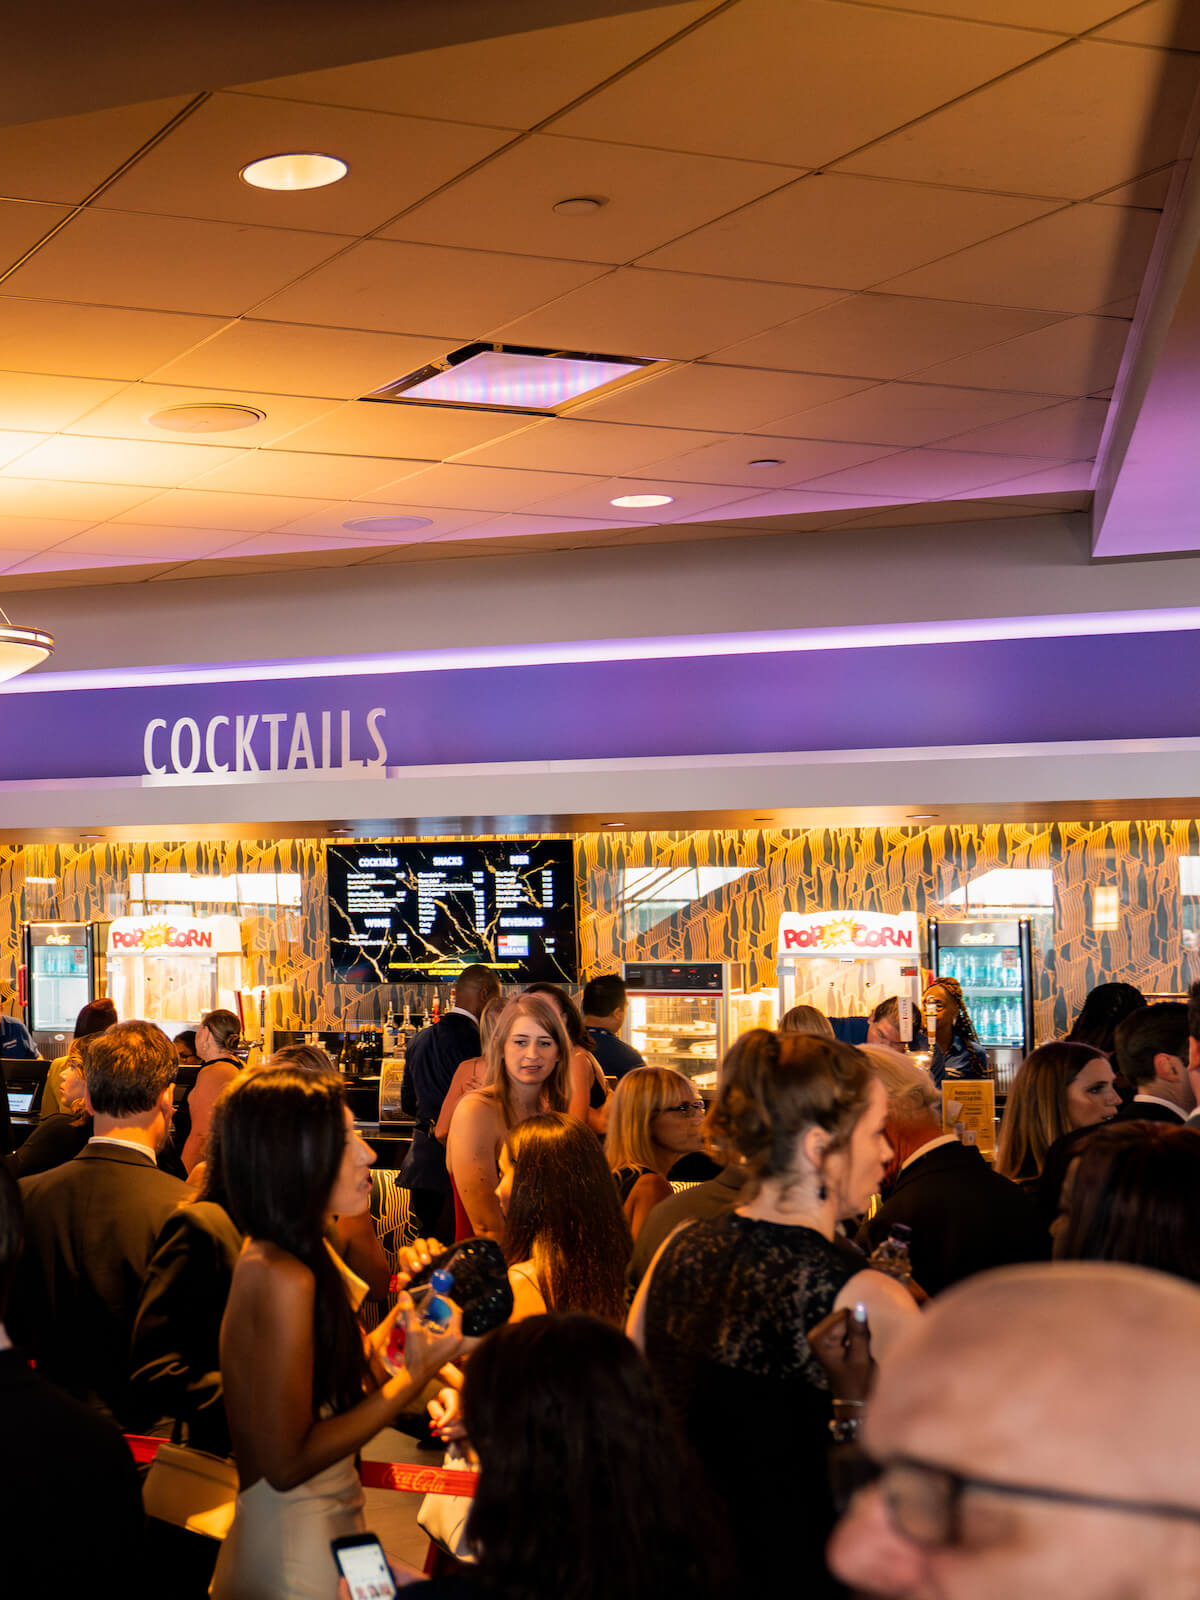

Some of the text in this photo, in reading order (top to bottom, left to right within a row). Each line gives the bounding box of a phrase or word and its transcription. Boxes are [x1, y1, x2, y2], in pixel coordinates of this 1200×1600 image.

[143, 707, 388, 775] COCKTAILS
[358, 857, 398, 867] COCKTAILS
[432, 856, 463, 866] SNACKS
[364, 918, 391, 928] WINE
[111, 926, 212, 949] POP CORN
[783, 924, 913, 949] POP CORN
